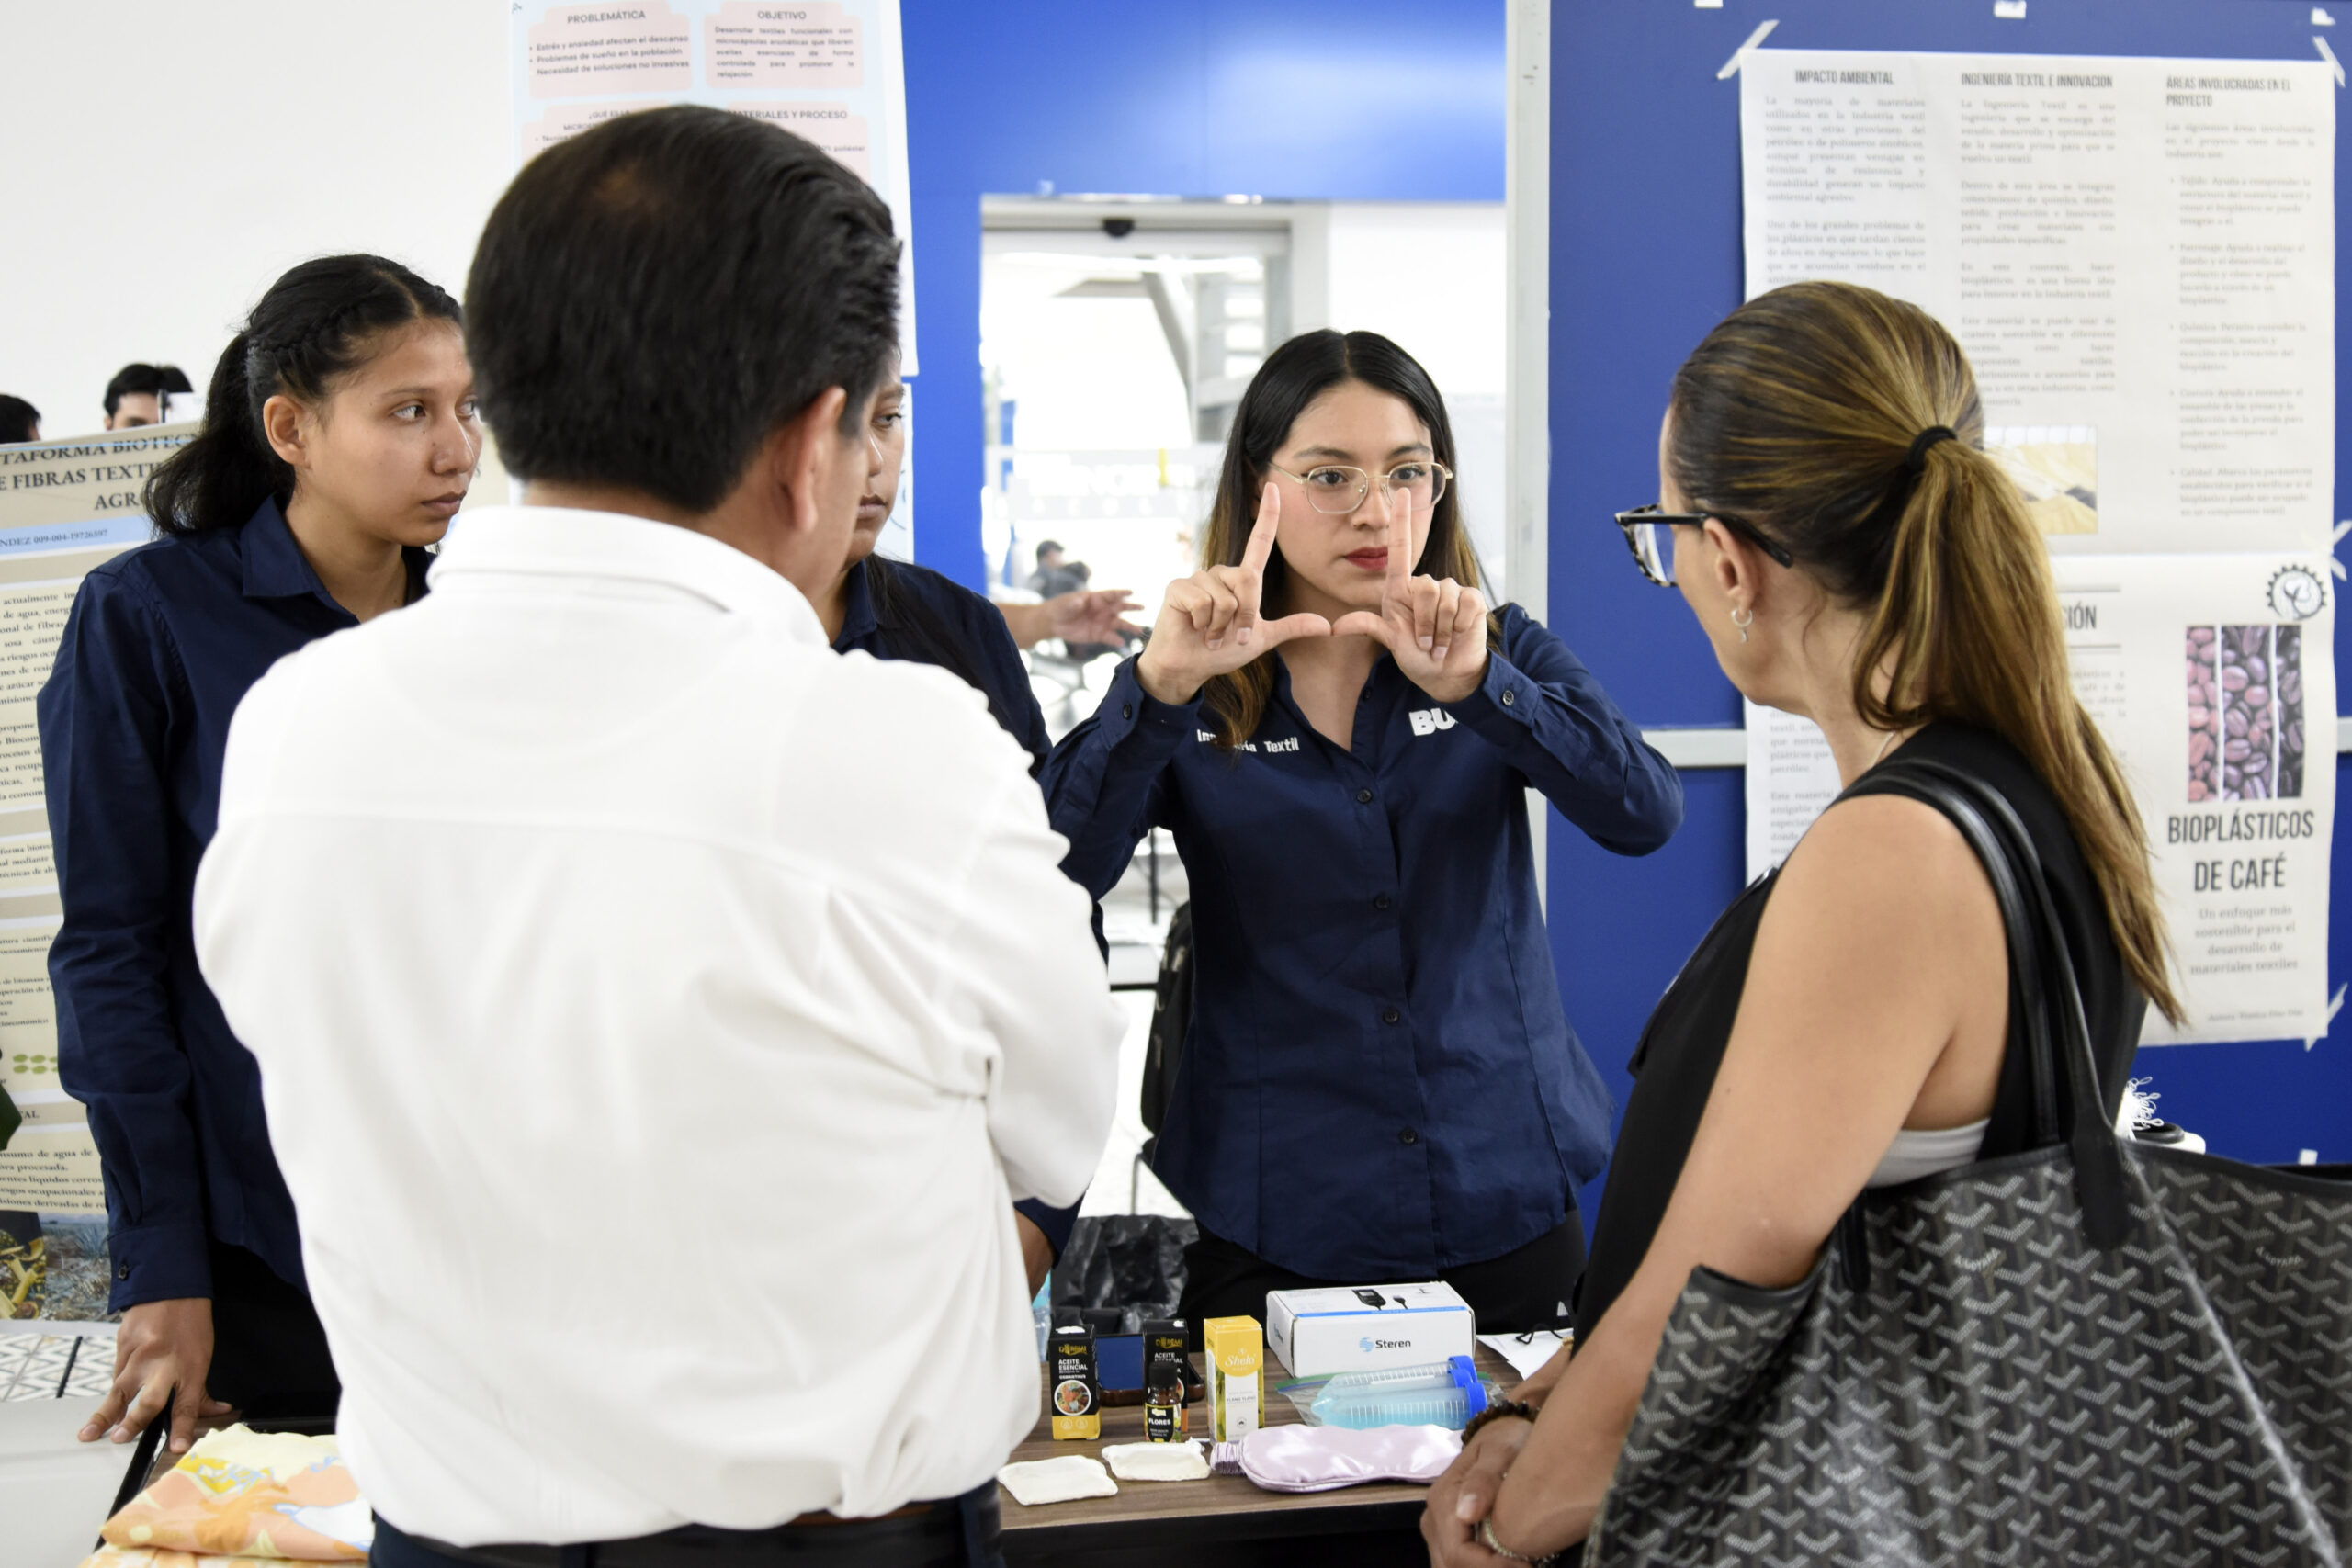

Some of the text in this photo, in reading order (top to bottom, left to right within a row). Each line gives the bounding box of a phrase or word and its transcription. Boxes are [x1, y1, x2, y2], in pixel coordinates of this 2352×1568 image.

[567, 10, 646, 24] PROBLEMÁTICA
[757, 10, 807, 19] OBJETIVO
[569, 40, 604, 49] ansiedad
[606, 38, 637, 47] afectan
[649, 35, 689, 44] descanso
[537, 53, 577, 62] Problemas
[640, 48, 683, 59] población
[651, 60, 689, 69] invasivas
[1795, 70, 1894, 85] IMPACTO AMBIENTAL
[1961, 72, 2013, 86] INGENIERÍA
[2016, 74, 2045, 87] TEXTIL
[2048, 74, 2055, 87] E
[2198, 77, 2266, 91] INVOLUCRADAS
[2267, 79, 2279, 91] EN
[2281, 79, 2292, 91] EL
[2166, 94, 2213, 107] PROYECTO
[789, 110, 797, 118] Y
[800, 110, 847, 119] PROCESO
[12, 468, 87, 490] FIBRAS
[4, 594, 59, 605] actualmente
[4, 610, 14, 619] de
[18, 610, 41, 620] agua,
[23, 623, 34, 632] de
[7, 652, 38, 662] riesgos
[18, 666, 29, 675] de
[1264, 737, 1300, 753] Textil
[2168, 807, 2315, 844] BIOPLÁSTICOS
[2194, 852, 2287, 892] DE CAFÉ
[2199, 905, 2293, 920] Un enfoque más
[2195, 921, 2296, 938] sostenible para el
[2207, 941, 2284, 956] desarrollo de
[2190, 958, 2298, 975] materiales textiles
[37, 1149, 50, 1158] de
[53, 1150, 76, 1160] agua
[80, 1148, 93, 1157] de
[17, 1163, 69, 1173] procesada.
[34, 1199, 93, 1209] derivadas de
[1375, 1339, 1411, 1348] Steren
[1148, 1417, 1171, 1426] FLORES
